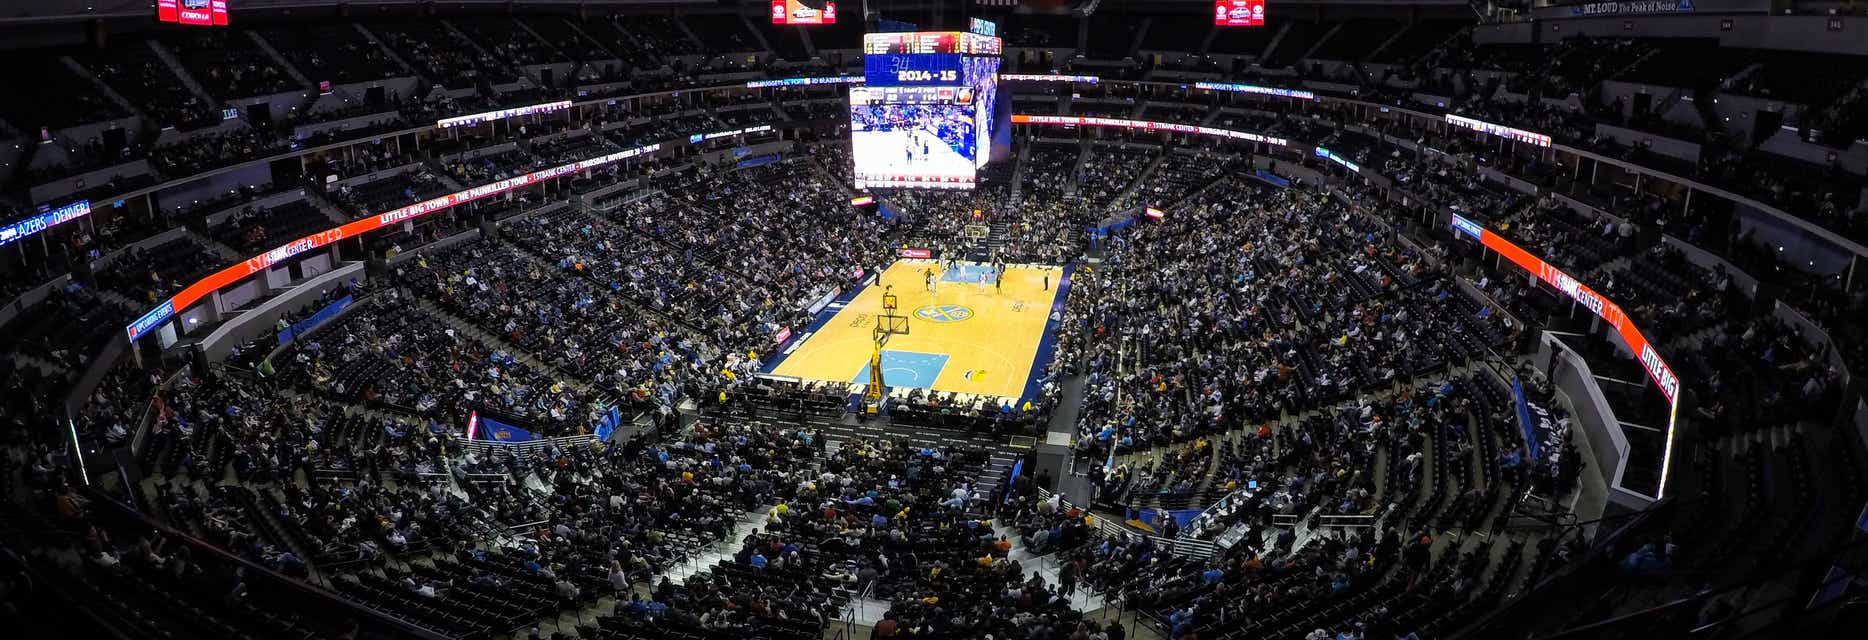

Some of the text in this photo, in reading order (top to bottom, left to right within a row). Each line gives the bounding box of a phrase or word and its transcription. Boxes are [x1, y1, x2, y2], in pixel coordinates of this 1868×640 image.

[1597, 2, 1617, 13] LOUD
[1631, 2, 1647, 12] Peak
[1648, 1, 1655, 11] of
[1656, 1, 1675, 11] Noise
[898, 70, 931, 81] 2014
[940, 70, 956, 81] 15
[381, 207, 408, 224] LITTLE
[409, 203, 425, 216] BIG
[425, 197, 449, 210] TOWN
[455, 190, 470, 202] THE
[470, 182, 510, 198] PAINKILLER
[510, 176, 528, 187] TOUR
[556, 163, 575, 175] CENTER
[287, 239, 313, 257] CENTER
[1577, 289, 1602, 316] CENTER
[1641, 343, 1676, 397] LITTLE BIG
